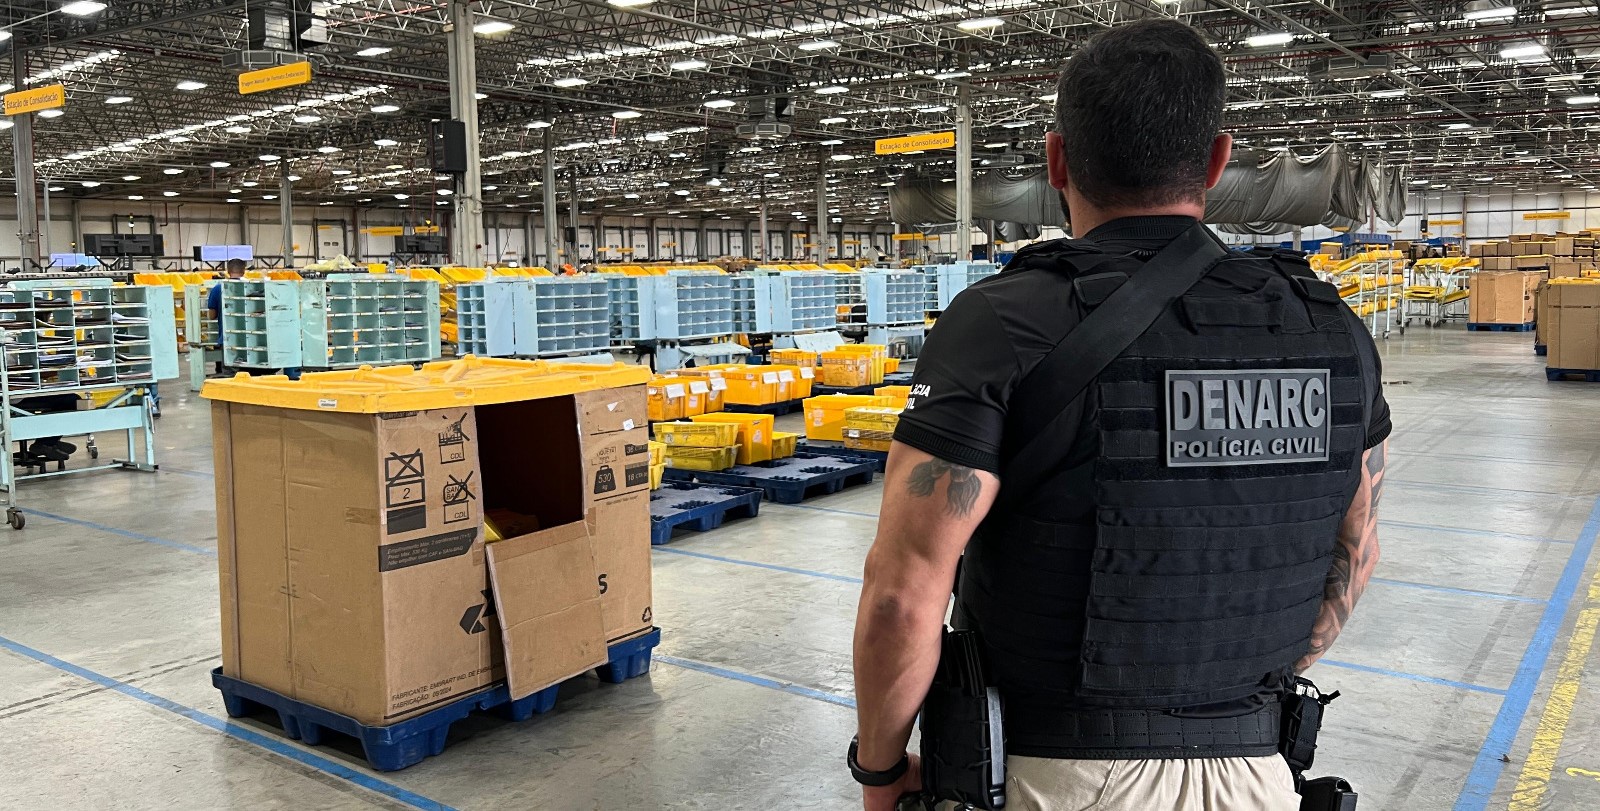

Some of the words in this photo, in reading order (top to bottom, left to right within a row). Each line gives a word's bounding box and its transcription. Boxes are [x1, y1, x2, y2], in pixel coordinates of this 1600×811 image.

[6, 100, 23, 110] Estação
[23, 98, 29, 107] de
[30, 92, 58, 106] Consolidação
[879, 143, 901, 151] Estação
[911, 137, 950, 148] Consolidação
[1170, 377, 1326, 431] DENARC
[1171, 436, 1264, 458] POLÍCIA
[1270, 437, 1325, 455] CIVIL
[598, 472, 612, 484] 530
[402, 487, 411, 500] 2
[391, 685, 429, 702] FABRICANTE:
[468, 670, 476, 678] DE
